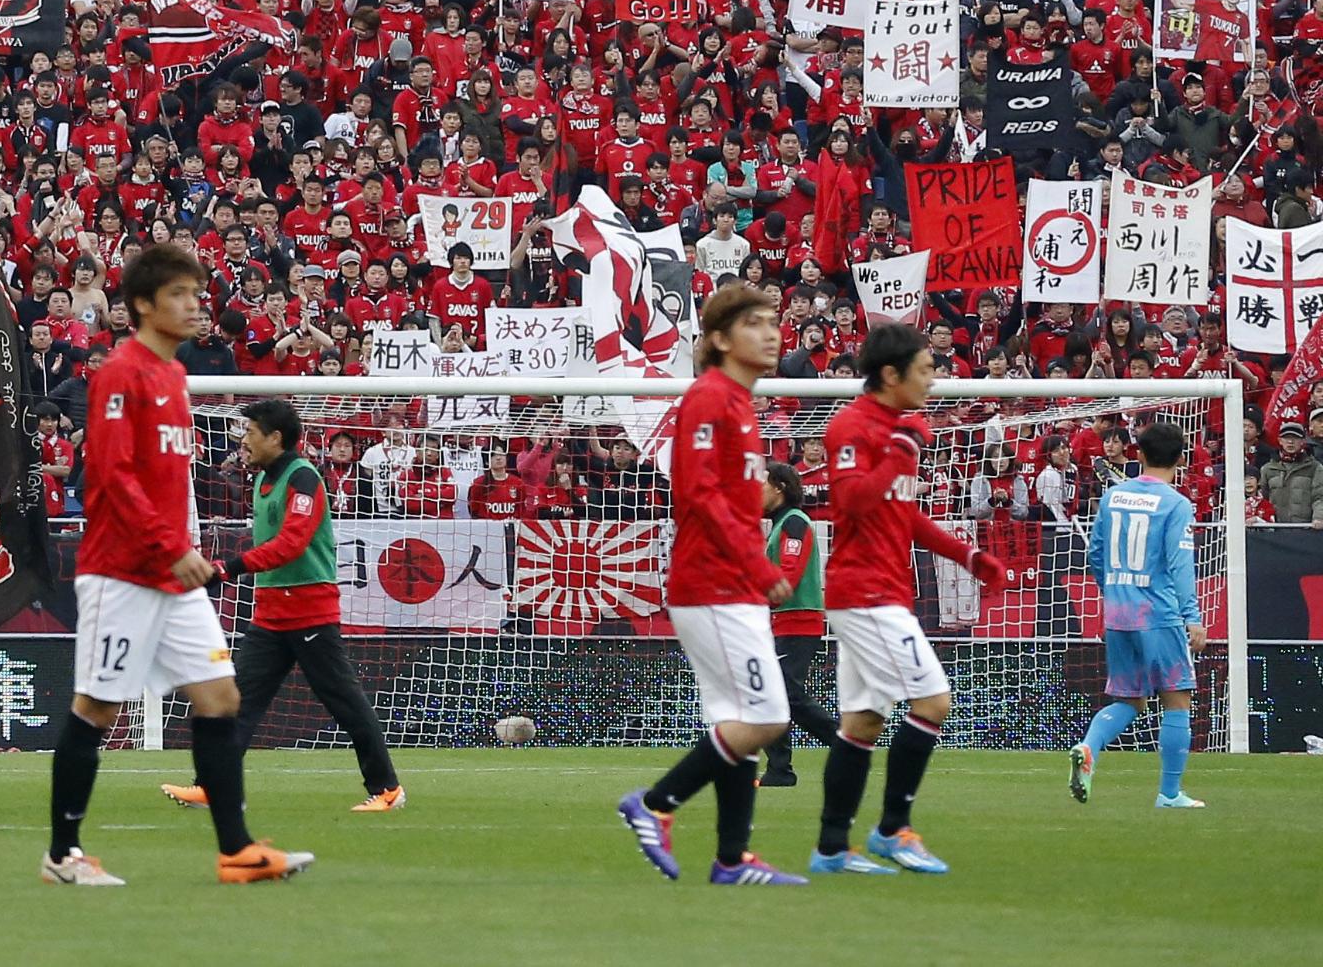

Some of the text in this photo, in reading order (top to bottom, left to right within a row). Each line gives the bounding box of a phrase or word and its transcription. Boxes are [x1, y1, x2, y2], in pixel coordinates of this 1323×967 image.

[872, 0, 949, 18] Fight
[869, 19, 954, 36] it out
[892, 40, 930, 86] 闘
[995, 66, 1063, 83] URAWA
[865, 92, 959, 106] Win victory
[1000, 120, 1059, 136] REDS
[914, 162, 1009, 209] PRIDE
[470, 201, 507, 230] 29
[1131, 201, 1189, 221] 司令塔
[941, 212, 987, 248] OF
[1115, 223, 1180, 256] 西川
[858, 267, 879, 283] We
[1032, 235, 1063, 294] 浦和
[874, 280, 903, 293] are
[1126, 263, 1200, 300] 周作
[882, 289, 921, 311] REDS
[493, 315, 572, 343] 決めろ
[373, 338, 429, 371] 柏木
[430, 352, 503, 378] 輝くんだ
[1111, 495, 1156, 509] GlassOne
[1109, 511, 1150, 570] 10
[101, 634, 131, 672] 12
[900, 635, 922, 668] 7
[746, 657, 764, 692] 8
